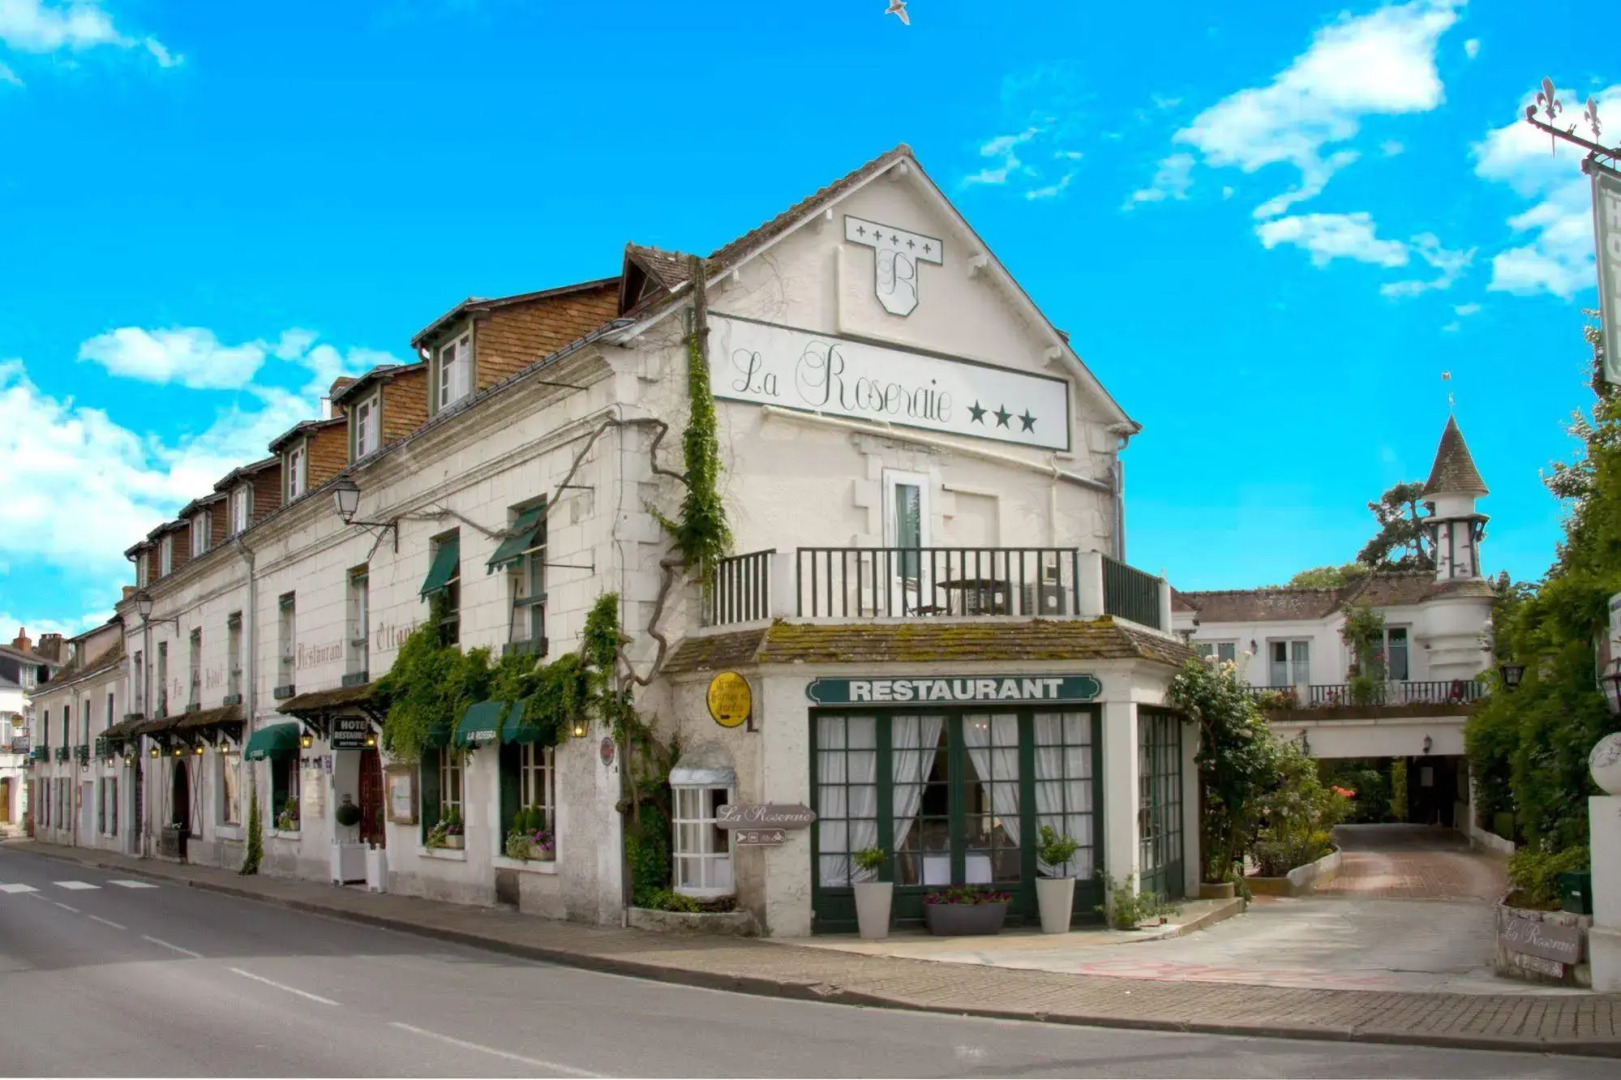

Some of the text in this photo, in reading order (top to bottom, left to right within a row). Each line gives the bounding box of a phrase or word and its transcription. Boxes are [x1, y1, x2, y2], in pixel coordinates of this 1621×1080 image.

[732, 340, 952, 423] La Roseraie
[296, 639, 343, 671] Restaurant
[850, 678, 1063, 701] RESTAURANT
[341, 720, 367, 730] HOTE
[334, 731, 366, 739] RESTAUR
[720, 806, 810, 821] La Roseraie
